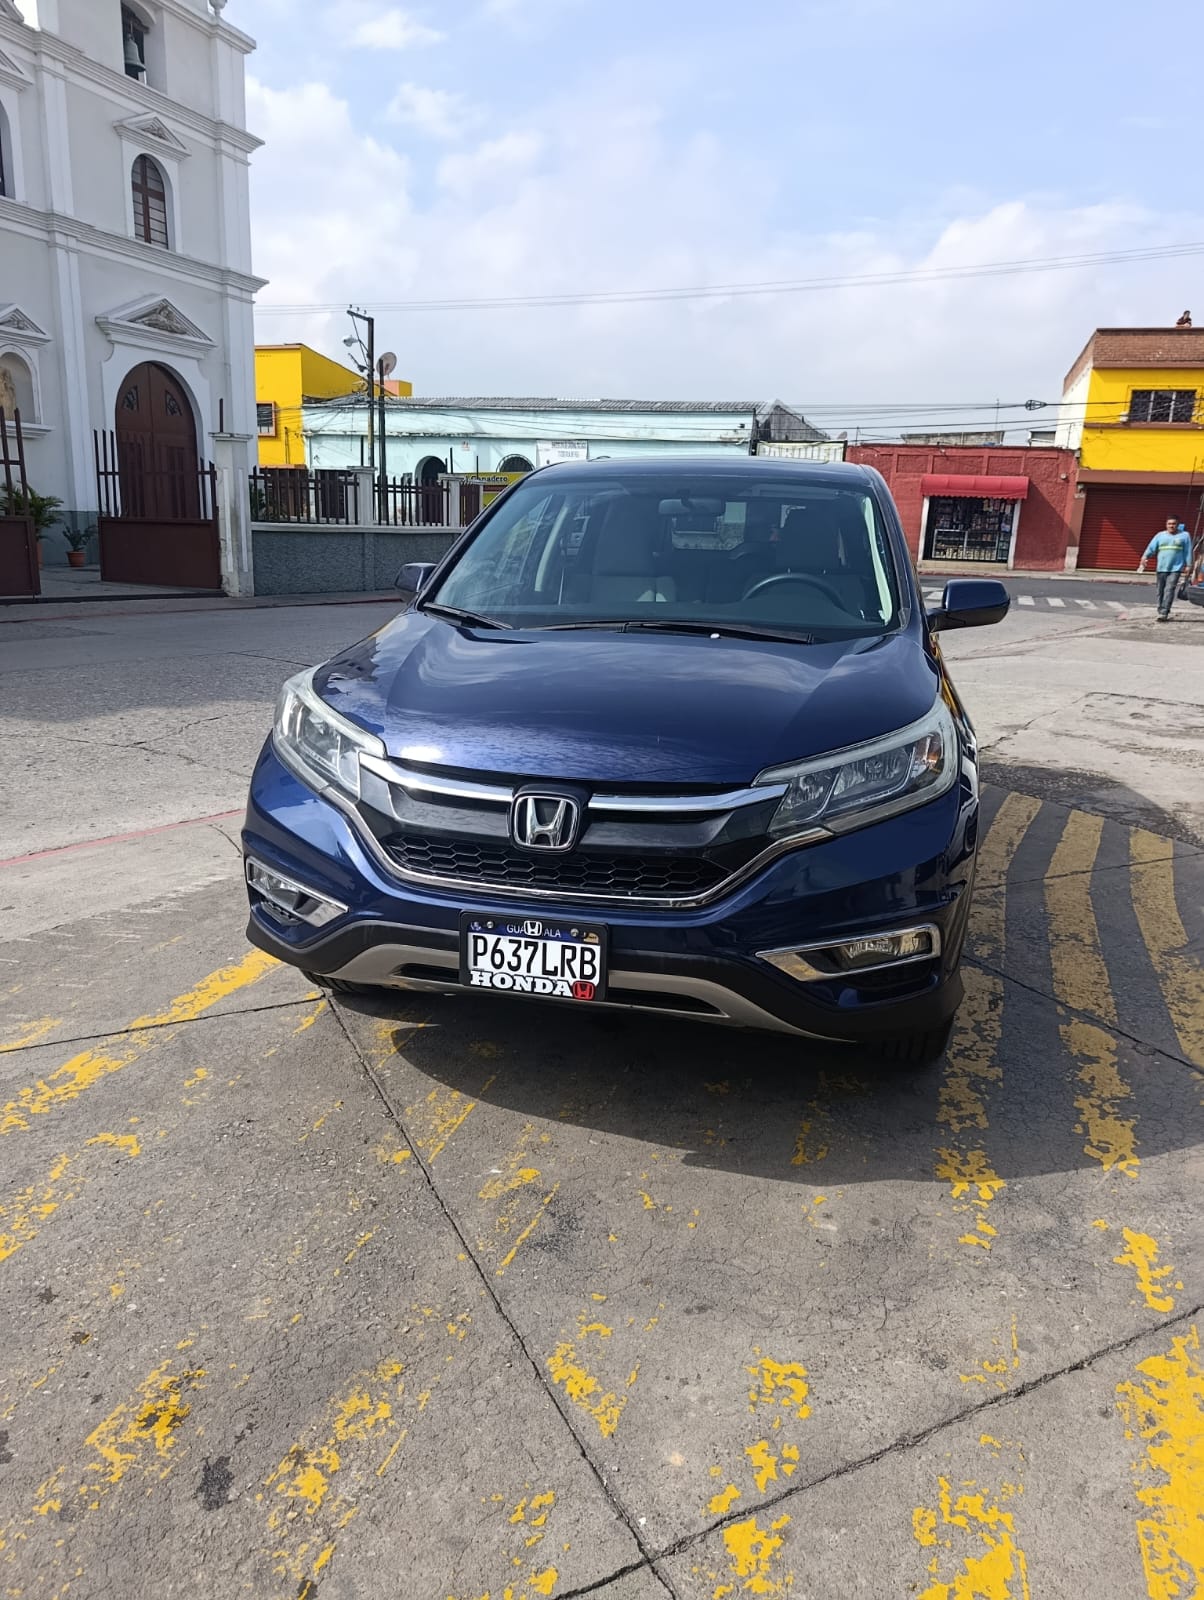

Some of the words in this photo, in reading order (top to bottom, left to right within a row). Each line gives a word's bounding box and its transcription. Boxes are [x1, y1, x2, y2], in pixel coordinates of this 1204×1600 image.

[506, 923, 562, 938] GUAALA
[472, 934, 597, 980] P637LRB
[470, 970, 574, 997] HONDA
